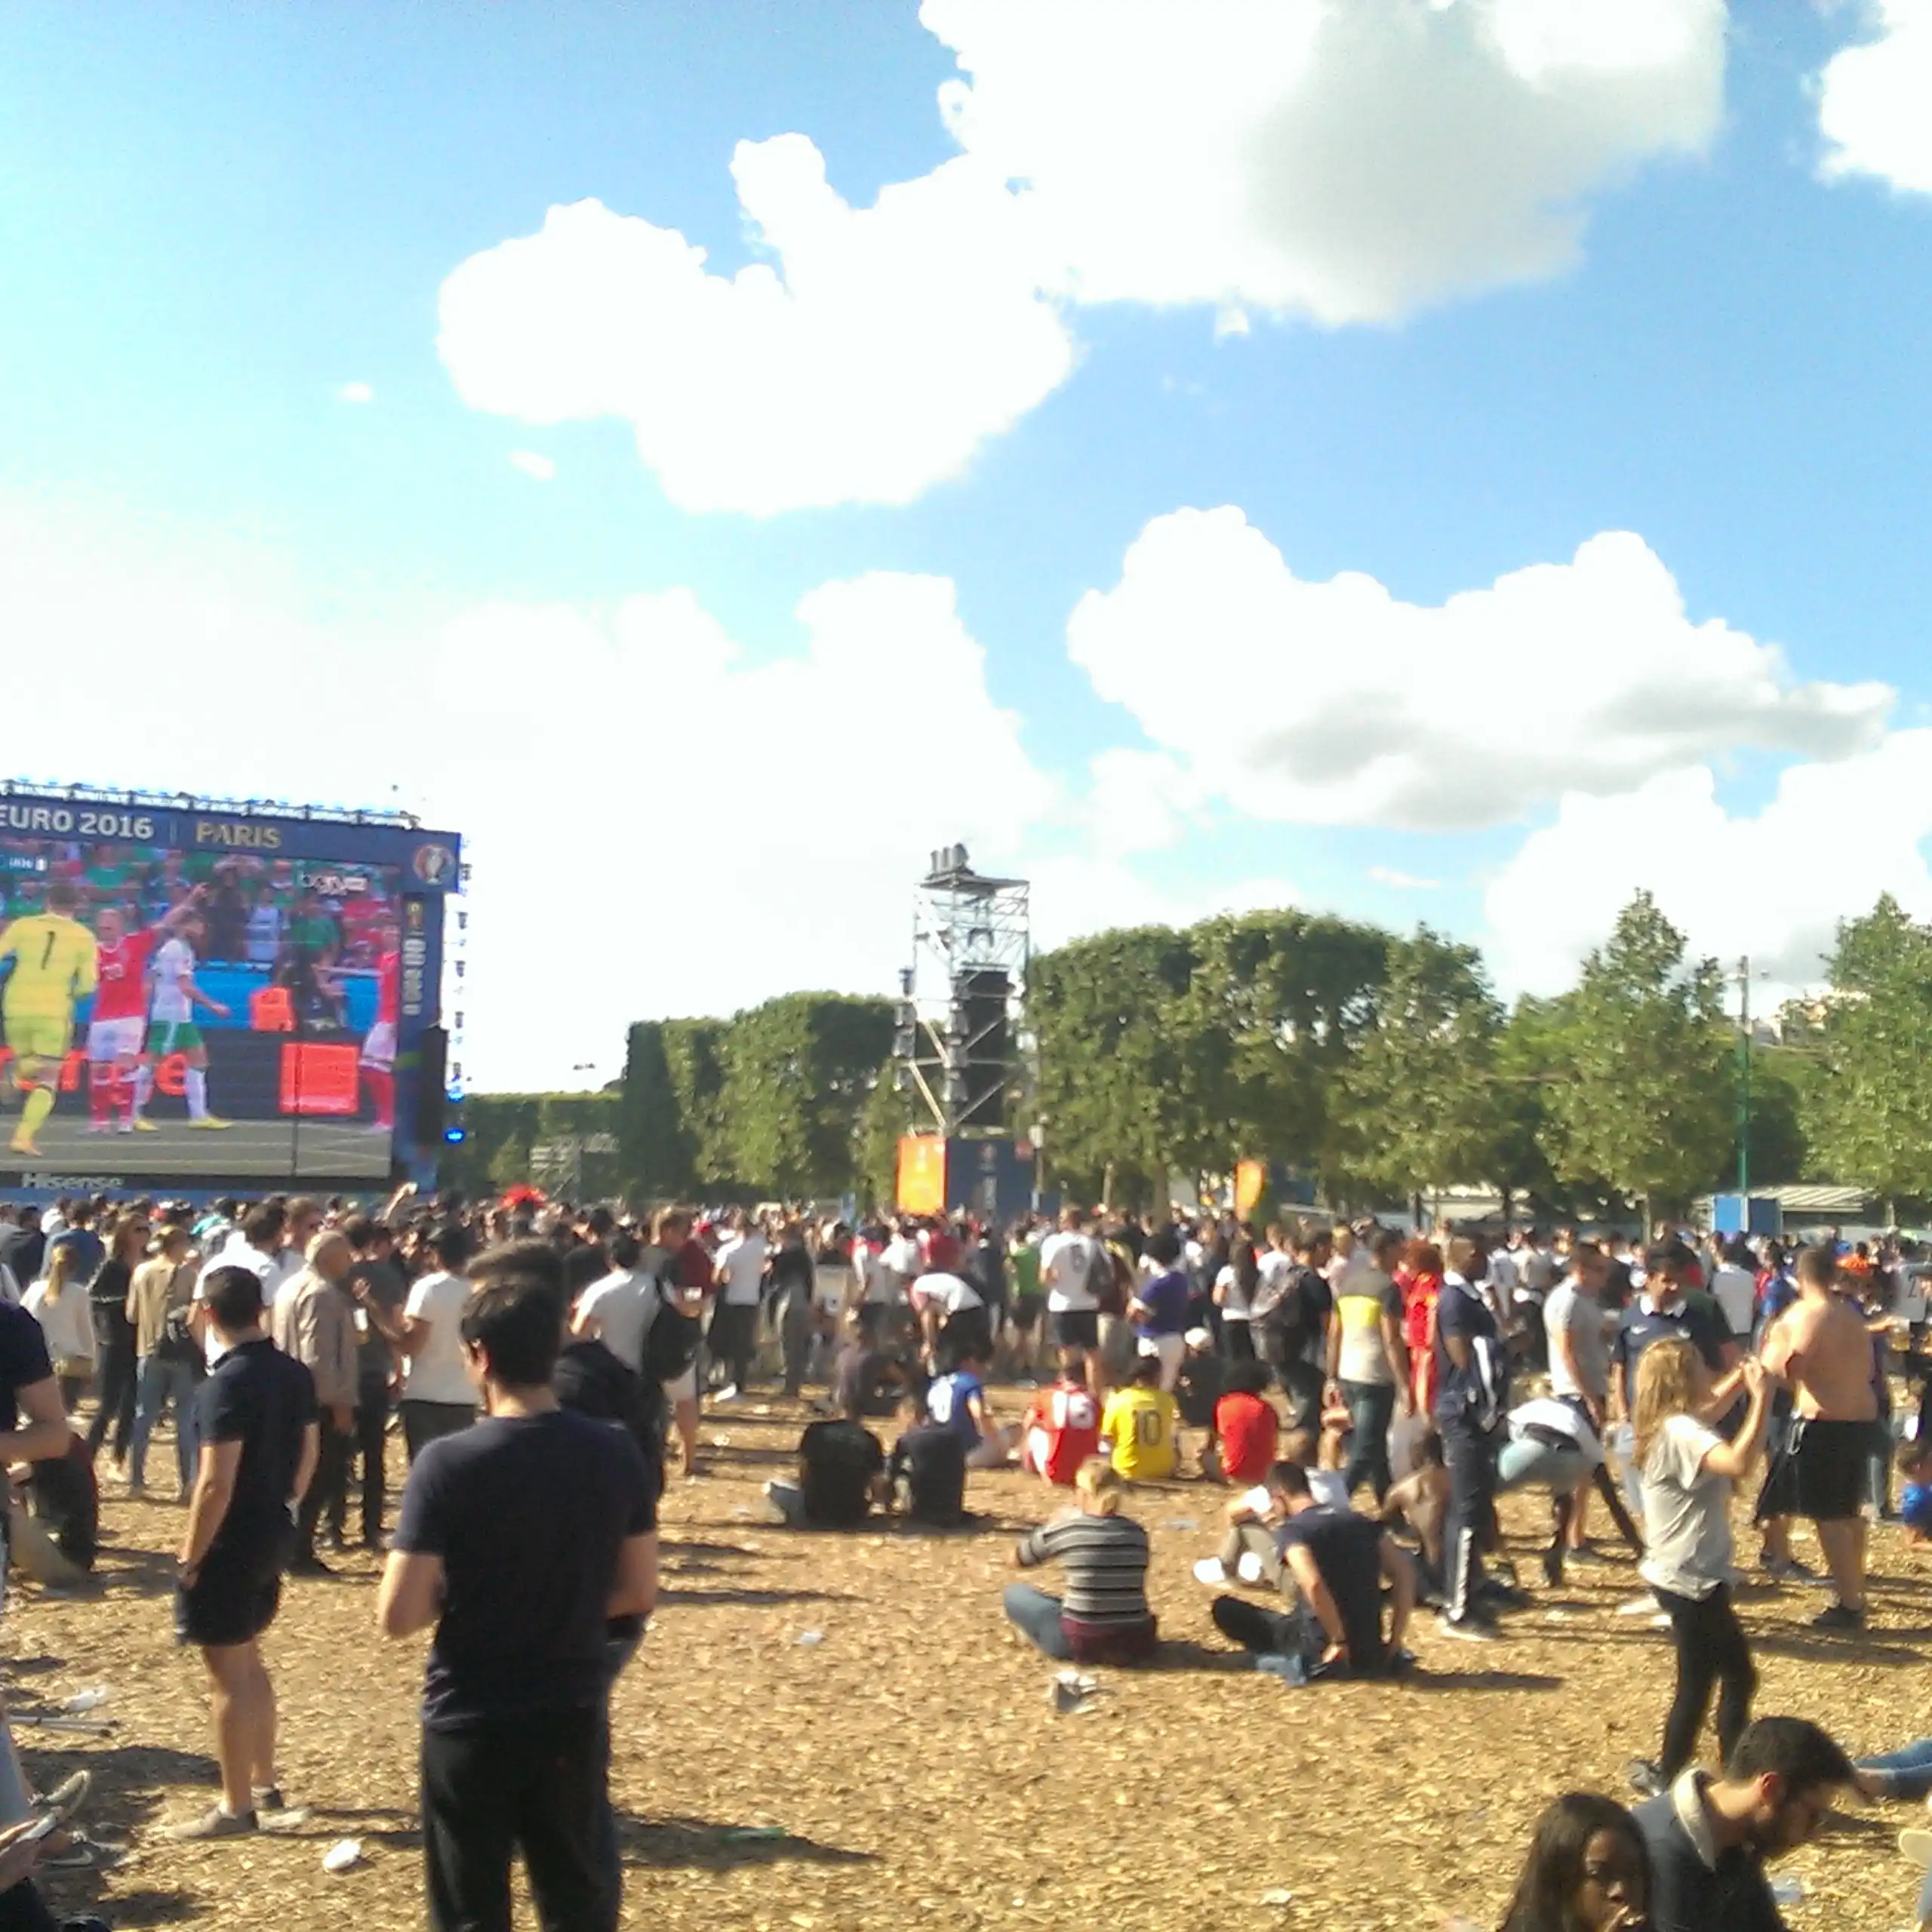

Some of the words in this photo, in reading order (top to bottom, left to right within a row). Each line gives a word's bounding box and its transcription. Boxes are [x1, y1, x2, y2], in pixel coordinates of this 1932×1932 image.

[78, 811, 155, 840] 2016
[196, 820, 282, 850] PARIS
[1133, 1409, 1163, 1447] 10
